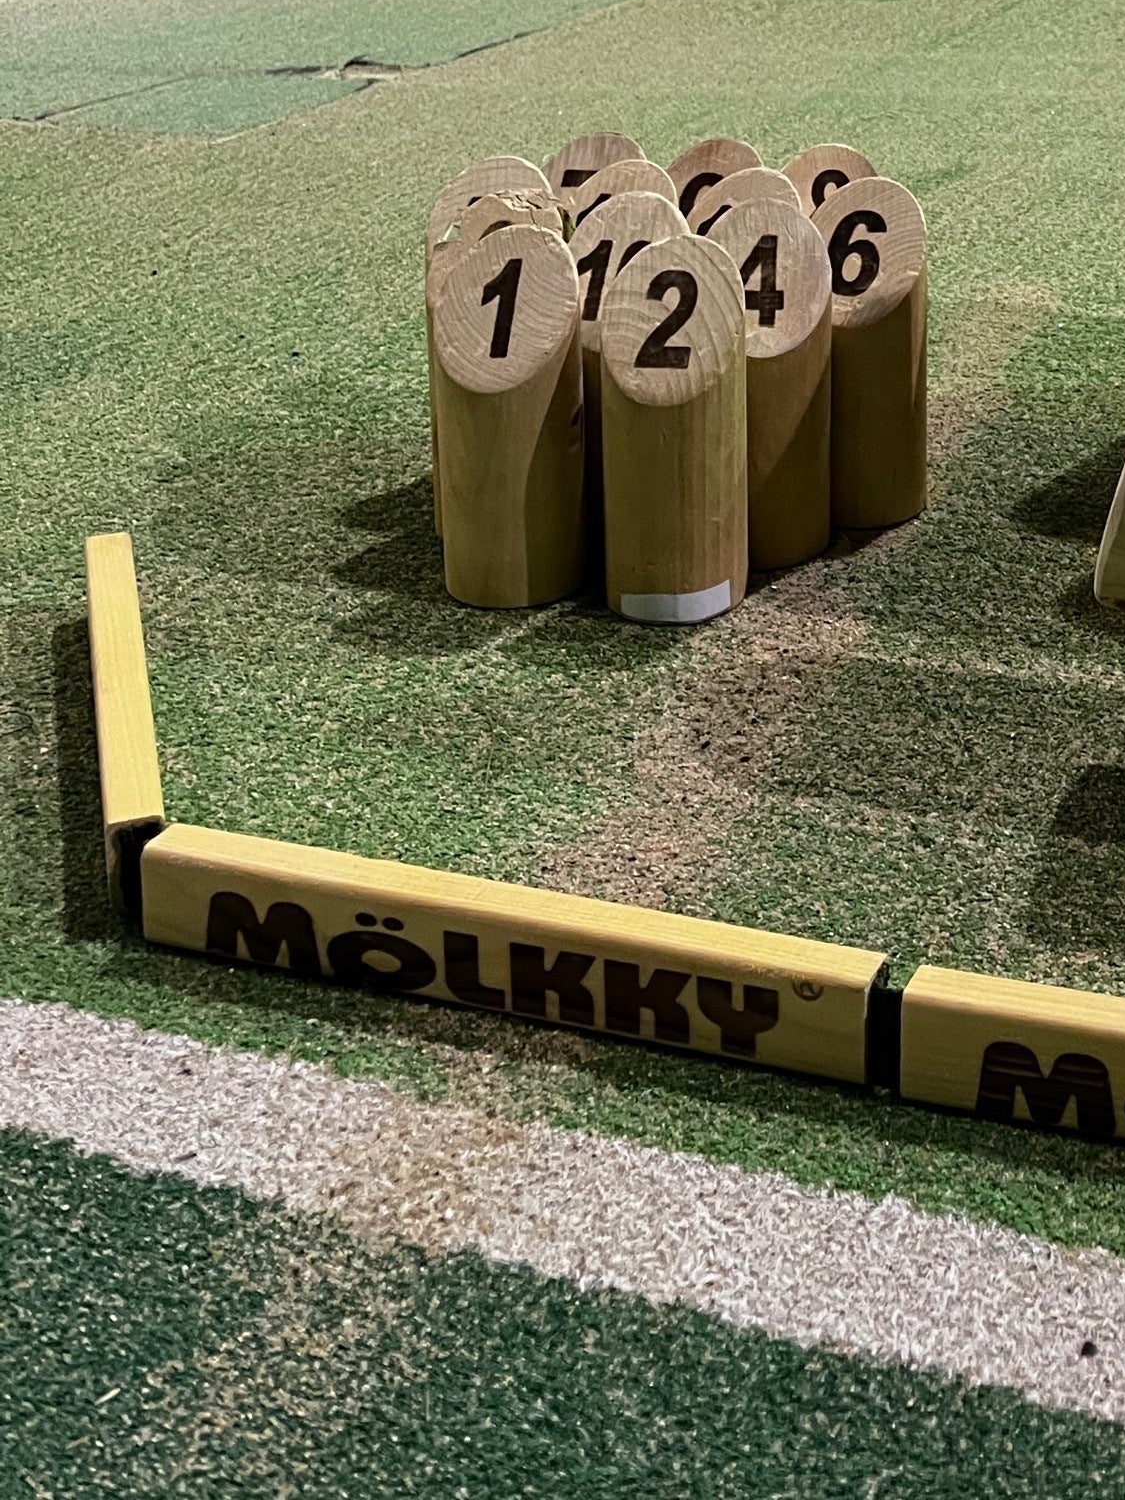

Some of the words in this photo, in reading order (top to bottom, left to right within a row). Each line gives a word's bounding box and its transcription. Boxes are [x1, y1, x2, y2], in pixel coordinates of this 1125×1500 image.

[740, 234, 785, 328] 4
[827, 210, 888, 297] 6
[481, 258, 523, 359] 1
[634, 269, 699, 369] 2
